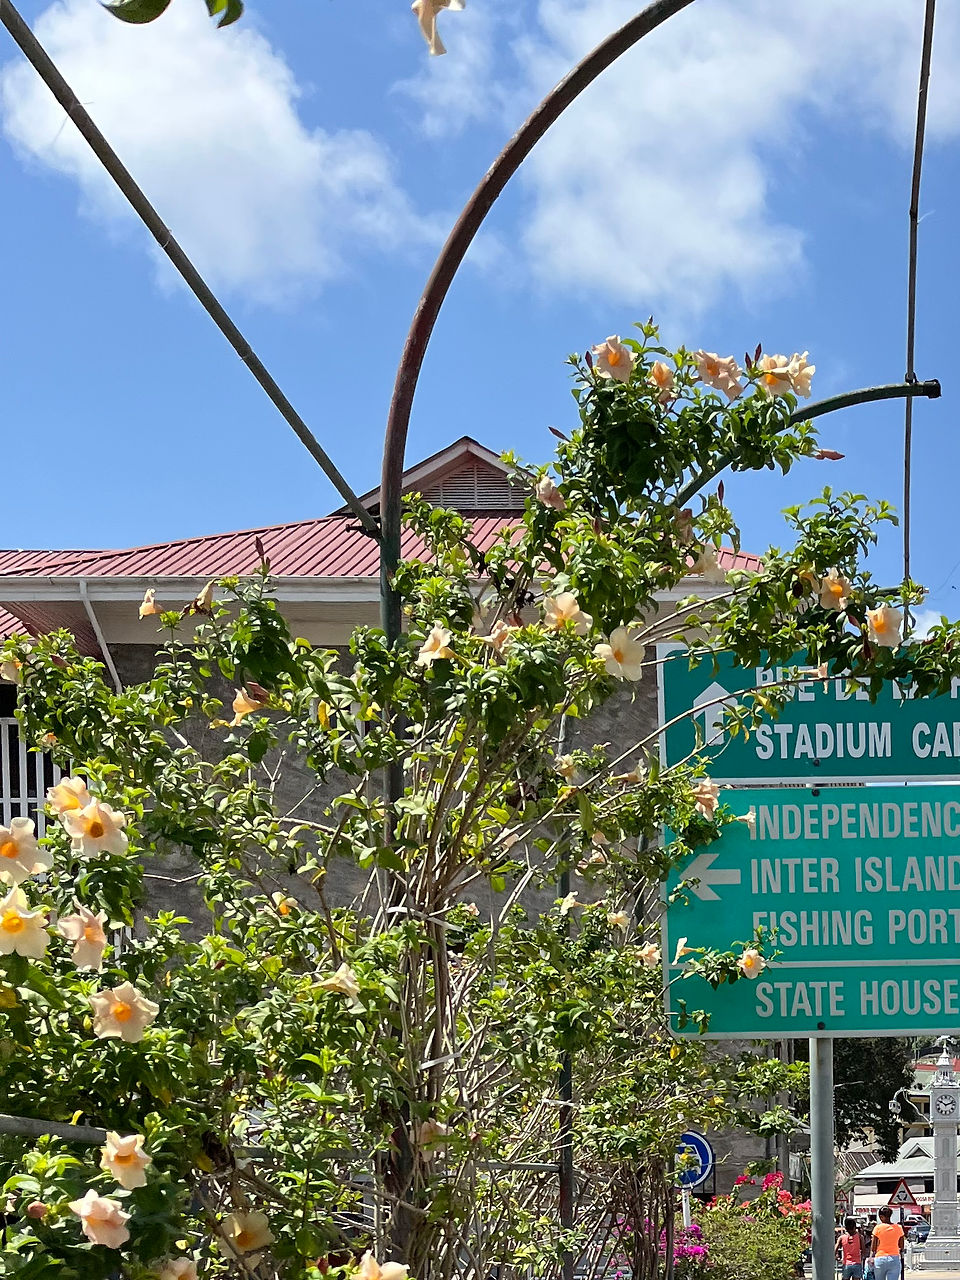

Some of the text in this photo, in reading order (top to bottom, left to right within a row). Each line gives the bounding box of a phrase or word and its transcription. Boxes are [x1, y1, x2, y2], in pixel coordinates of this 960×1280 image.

[755, 722, 891, 760] STADIUM
[752, 858, 839, 893] INTER
[752, 911, 872, 946] FISHING
[756, 982, 844, 1017] STATE
[861, 980, 958, 1015] HOUSE
